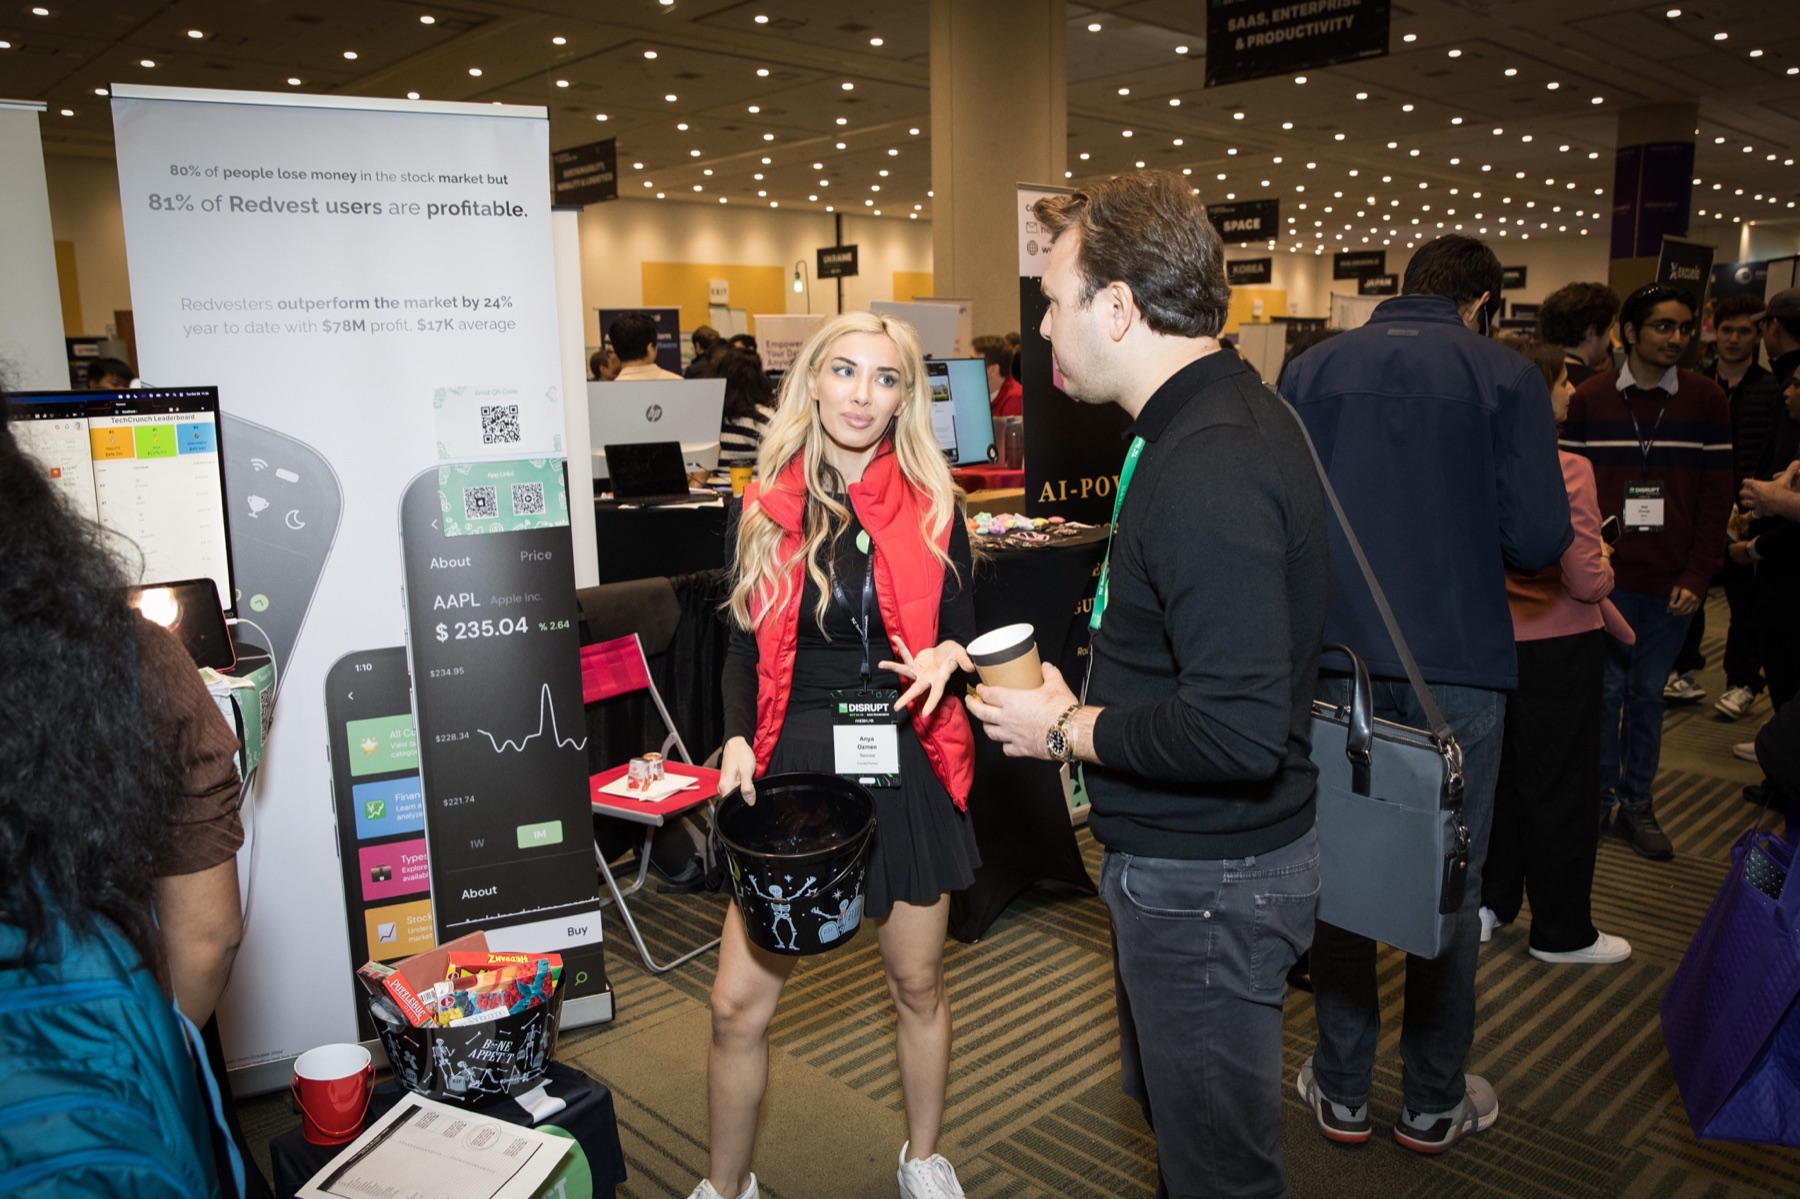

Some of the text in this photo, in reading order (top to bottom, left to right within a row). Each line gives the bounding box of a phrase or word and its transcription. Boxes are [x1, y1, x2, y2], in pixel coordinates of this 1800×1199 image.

[1228, 13, 1270, 33] SAAS,
[1234, 15, 1355, 51] & PRODUCTIVITY
[170, 164, 509, 185] 80% of people lose money in the stock market but
[148, 193, 528, 219] 81% of Redvest users are profitable.
[1223, 218, 1262, 232] SPACE
[1232, 264, 1265, 274] KOREA
[181, 295, 513, 312] Redvesters outperform the market by 24%
[183, 318, 516, 338] year to date with $78M profit. $17K average
[767, 349, 786, 357] Your
[111, 414, 195, 424] TechCrunch Leaderboard
[430, 549, 553, 570] About Price
[433, 592, 543, 610] AAPL Apple Inc.
[435, 616, 570, 643] $ 235.04 % 2.64
[355, 663, 373, 672] 1:10
[430, 666, 465, 678] $234.95
[849, 702, 889, 712] DISRUPT
[390, 729, 401, 739] All
[435, 731, 470, 743] $228.34
[390, 741, 409, 749] View
[443, 795, 475, 807] $221.74
[396, 804, 416, 813] Learn
[533, 829, 547, 840] 1M
[470, 838, 485, 849] 1W
[402, 864, 428, 874] Explore
[461, 885, 498, 900] About
[407, 913, 433, 925] Stock
[567, 926, 588, 937] Buy
[391, 978, 426, 1017] PUZZLEBUG
